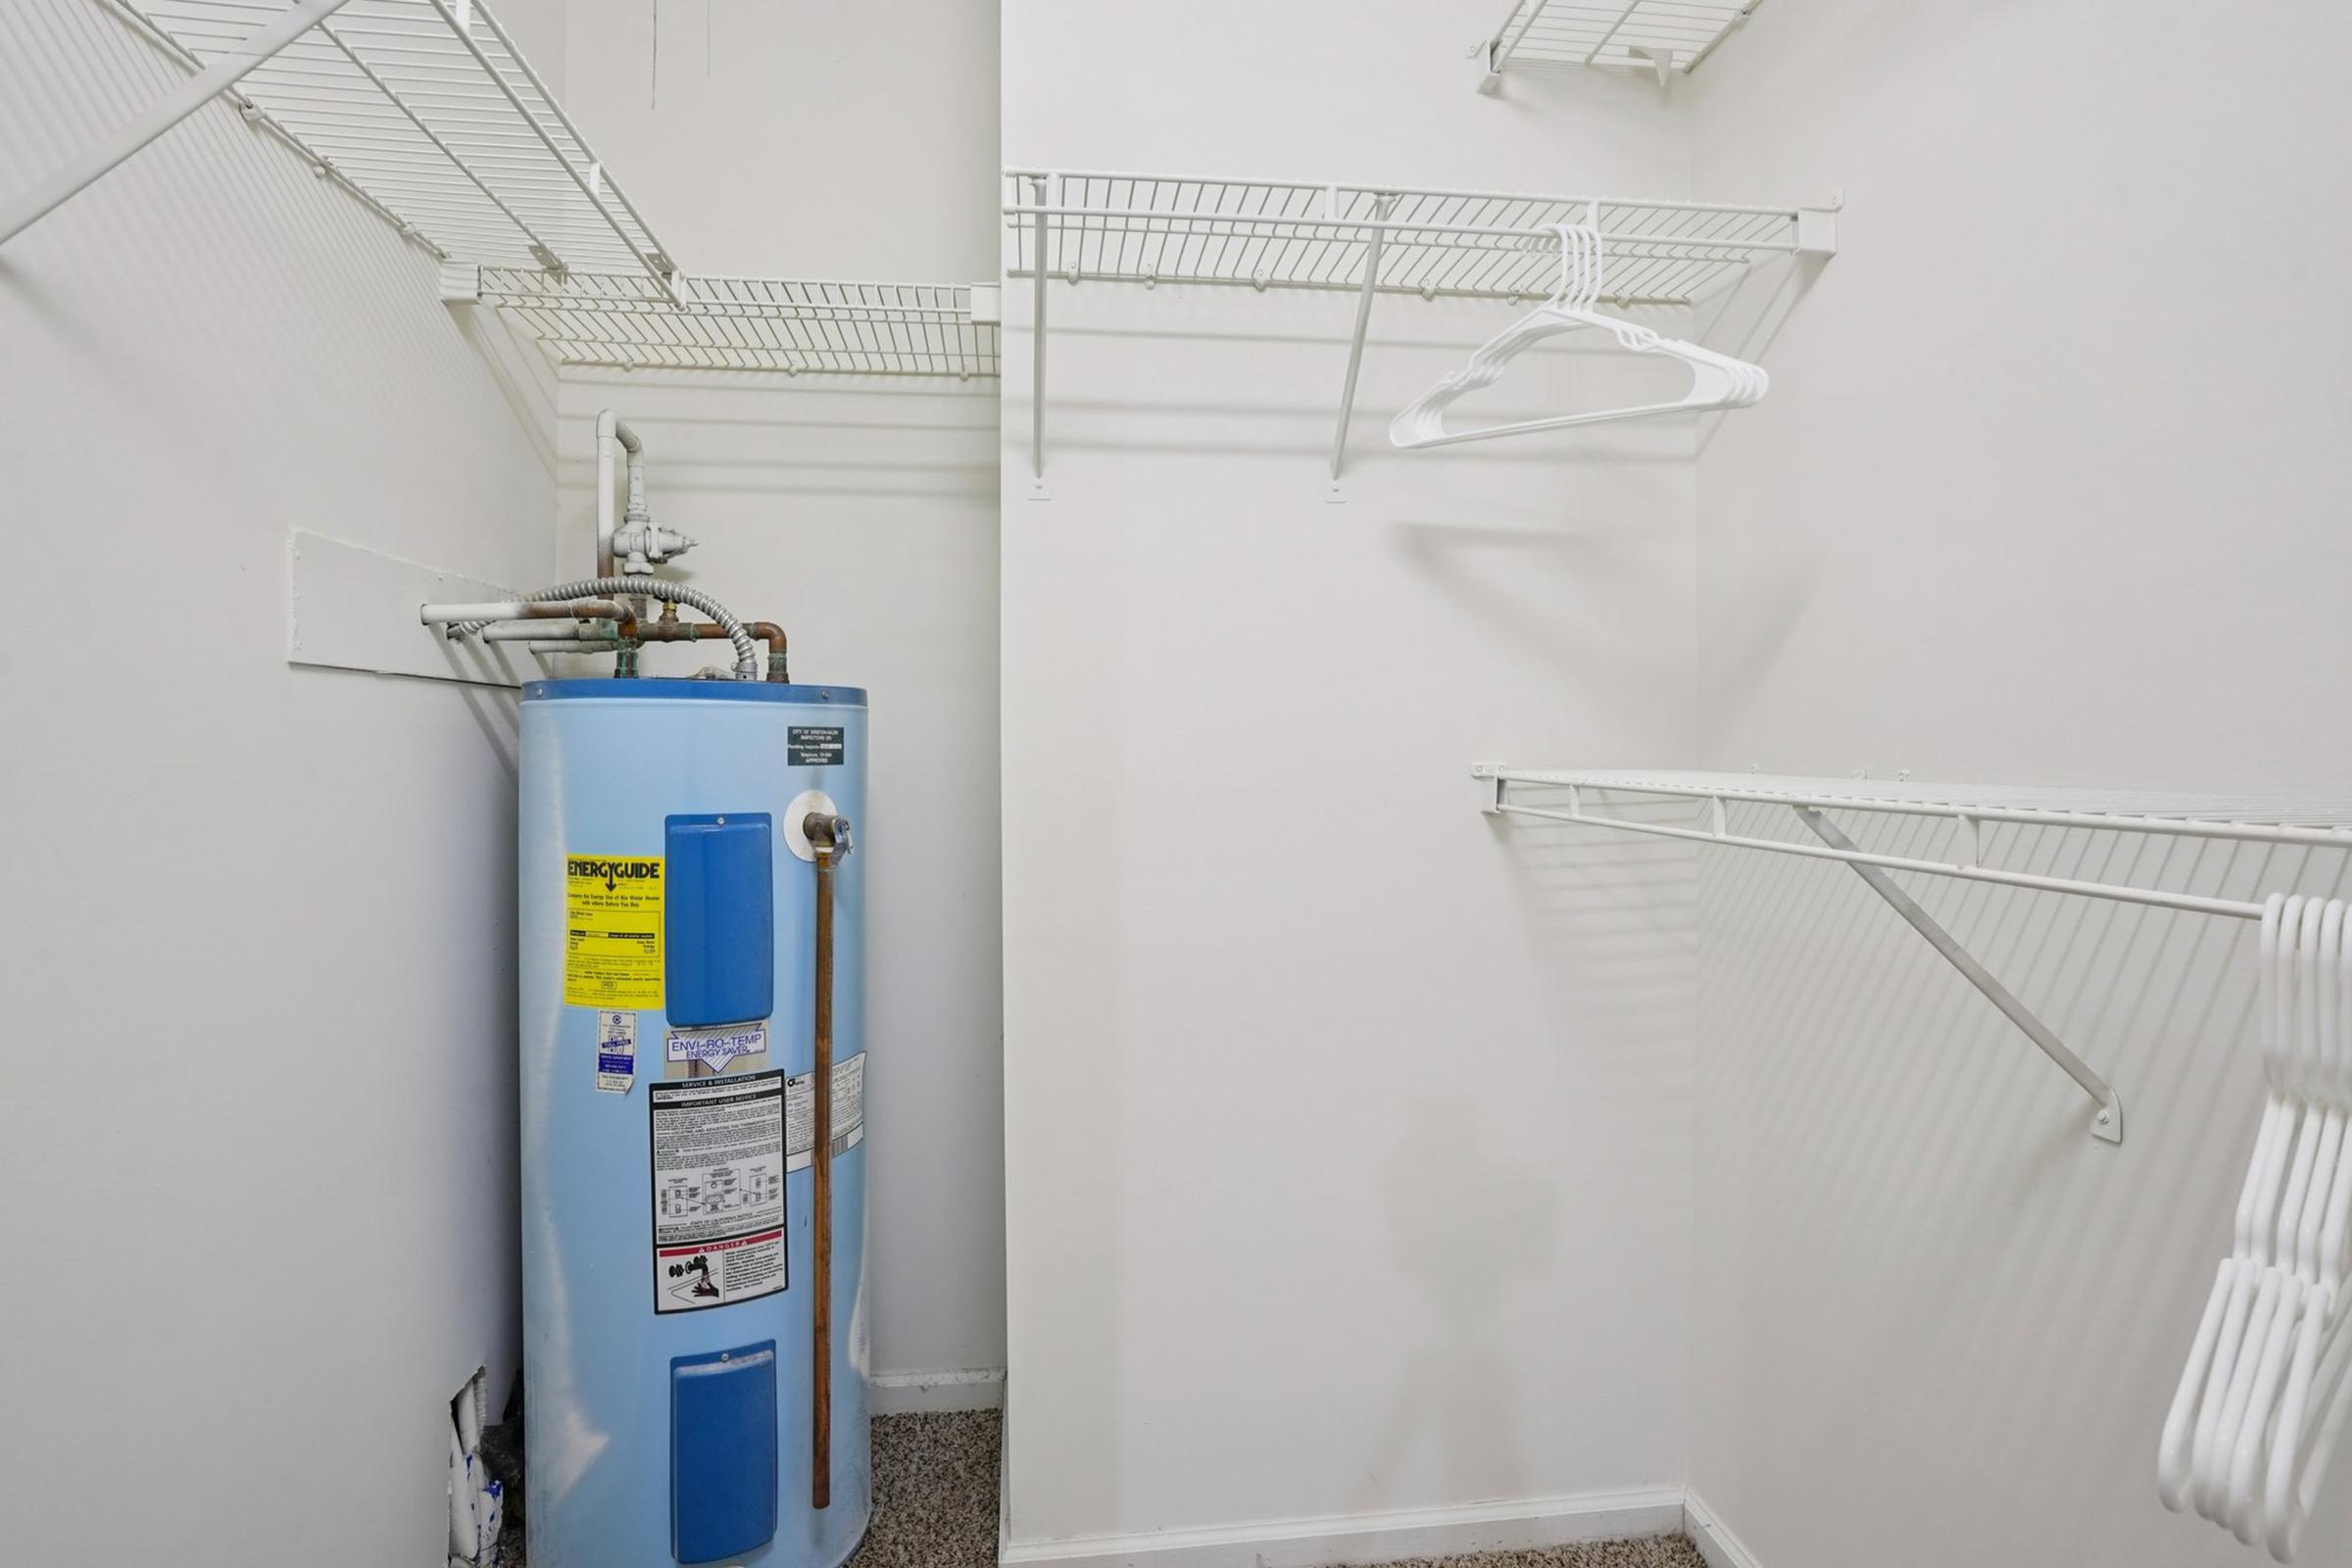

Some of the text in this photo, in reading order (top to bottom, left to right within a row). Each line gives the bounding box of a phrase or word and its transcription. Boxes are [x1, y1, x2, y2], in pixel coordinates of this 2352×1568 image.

[671, 1034, 761, 1052] ENVI-RO-TEMP
[686, 1046, 748, 1058] ENERGY SAVER
[714, 1075, 757, 1085] INSTALLATION
[681, 1099, 717, 1107] IMPORTANT
[707, 1242, 740, 1251] DANGER
